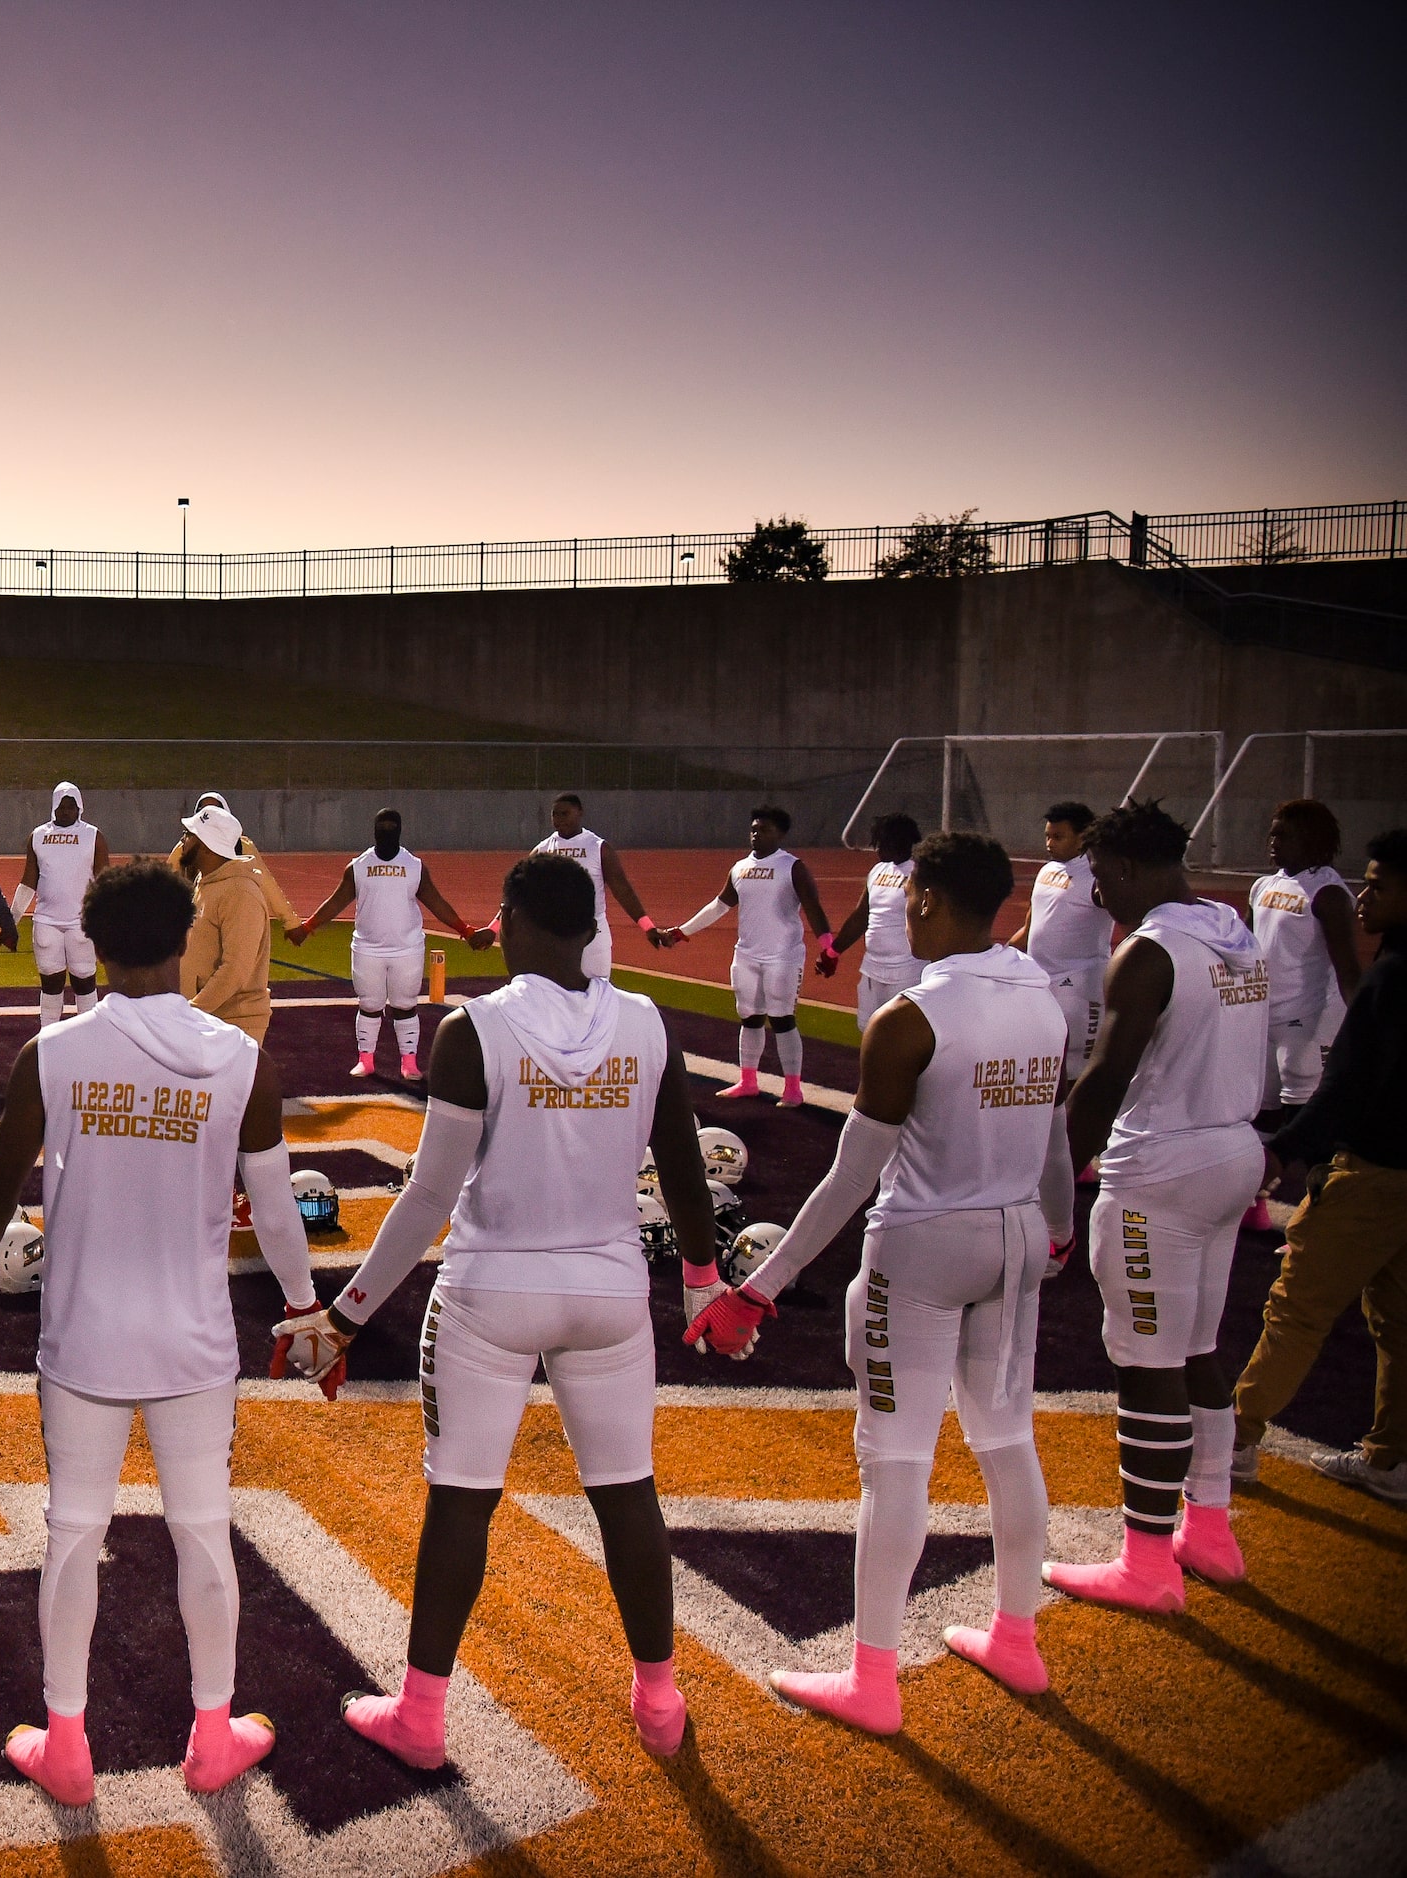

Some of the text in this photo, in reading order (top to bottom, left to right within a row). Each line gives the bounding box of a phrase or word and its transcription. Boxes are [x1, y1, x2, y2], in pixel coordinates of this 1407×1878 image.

[42, 834, 80, 845] MECCA
[366, 865, 407, 877] MECCA
[738, 868, 774, 880] MECCA
[1258, 890, 1307, 915] MECCA
[1219, 984, 1268, 1006] PROCESS
[973, 1058, 1015, 1088] 11.22.20
[71, 1081, 135, 1113] 11.22.20
[152, 1086, 213, 1122] 12.18.21
[528, 1086, 630, 1109] PROCESS
[980, 1084, 1054, 1109] PROCESS
[80, 1112, 199, 1144] PROCESS
[1123, 1209, 1157, 1336] OAK CLIFF
[422, 1297, 443, 1375] CLIFF
[865, 1268, 896, 1413] OAK CLIFF
